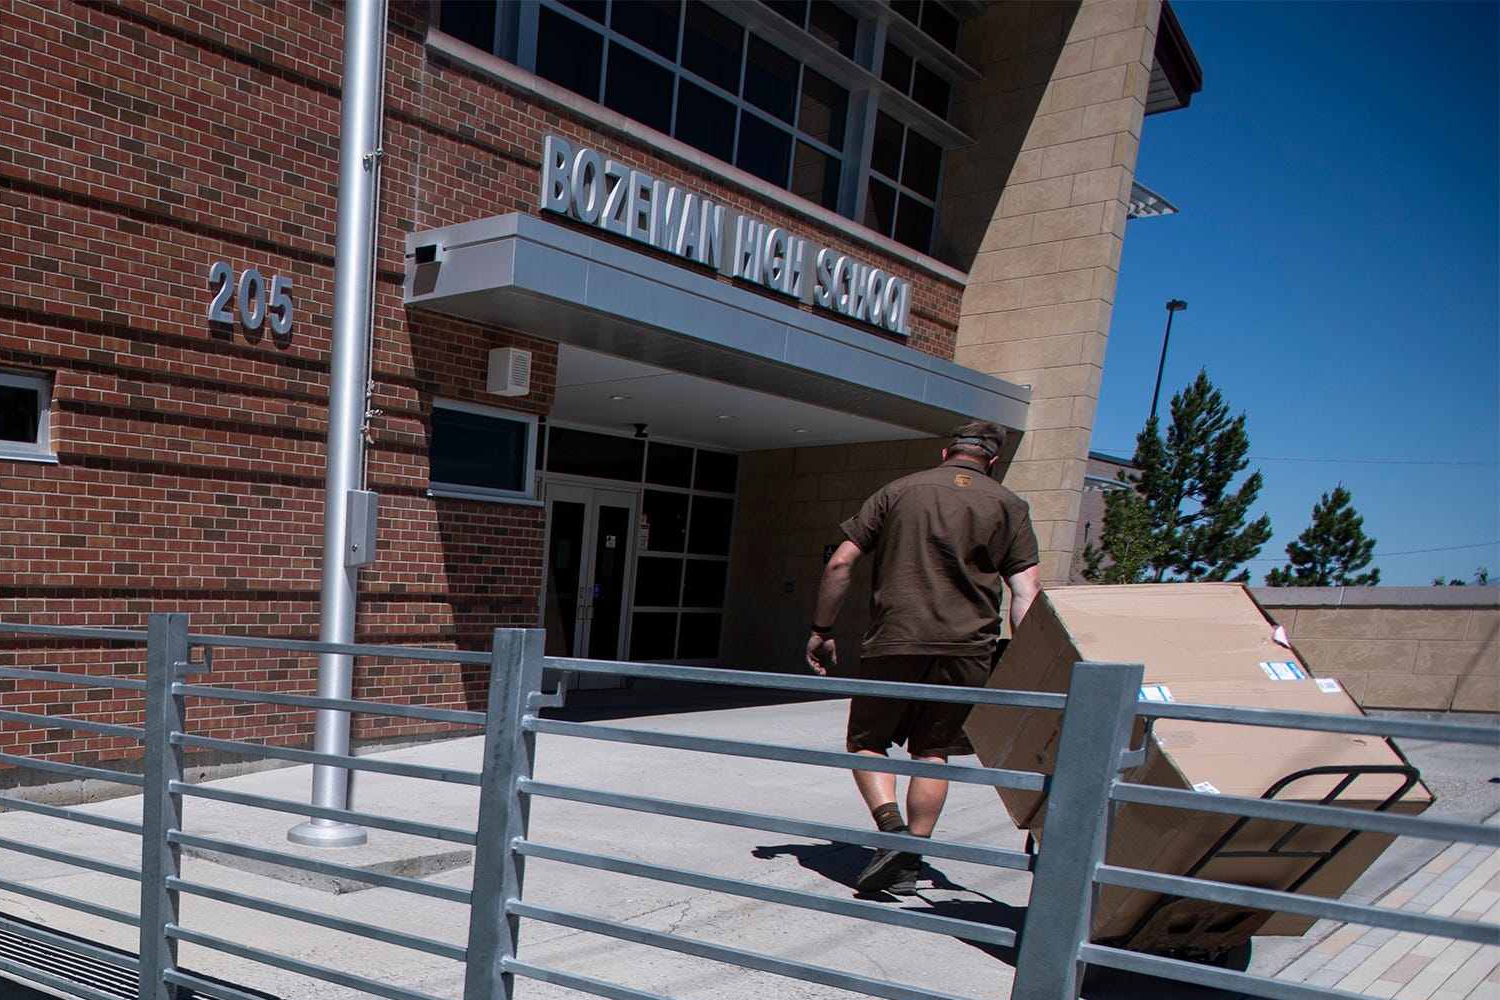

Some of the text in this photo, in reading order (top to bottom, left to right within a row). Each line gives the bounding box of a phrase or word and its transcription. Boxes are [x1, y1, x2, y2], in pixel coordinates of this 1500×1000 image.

[208, 261, 294, 335] 205
[541, 133, 912, 336] BOZEMAN HIGH SCHOOL
